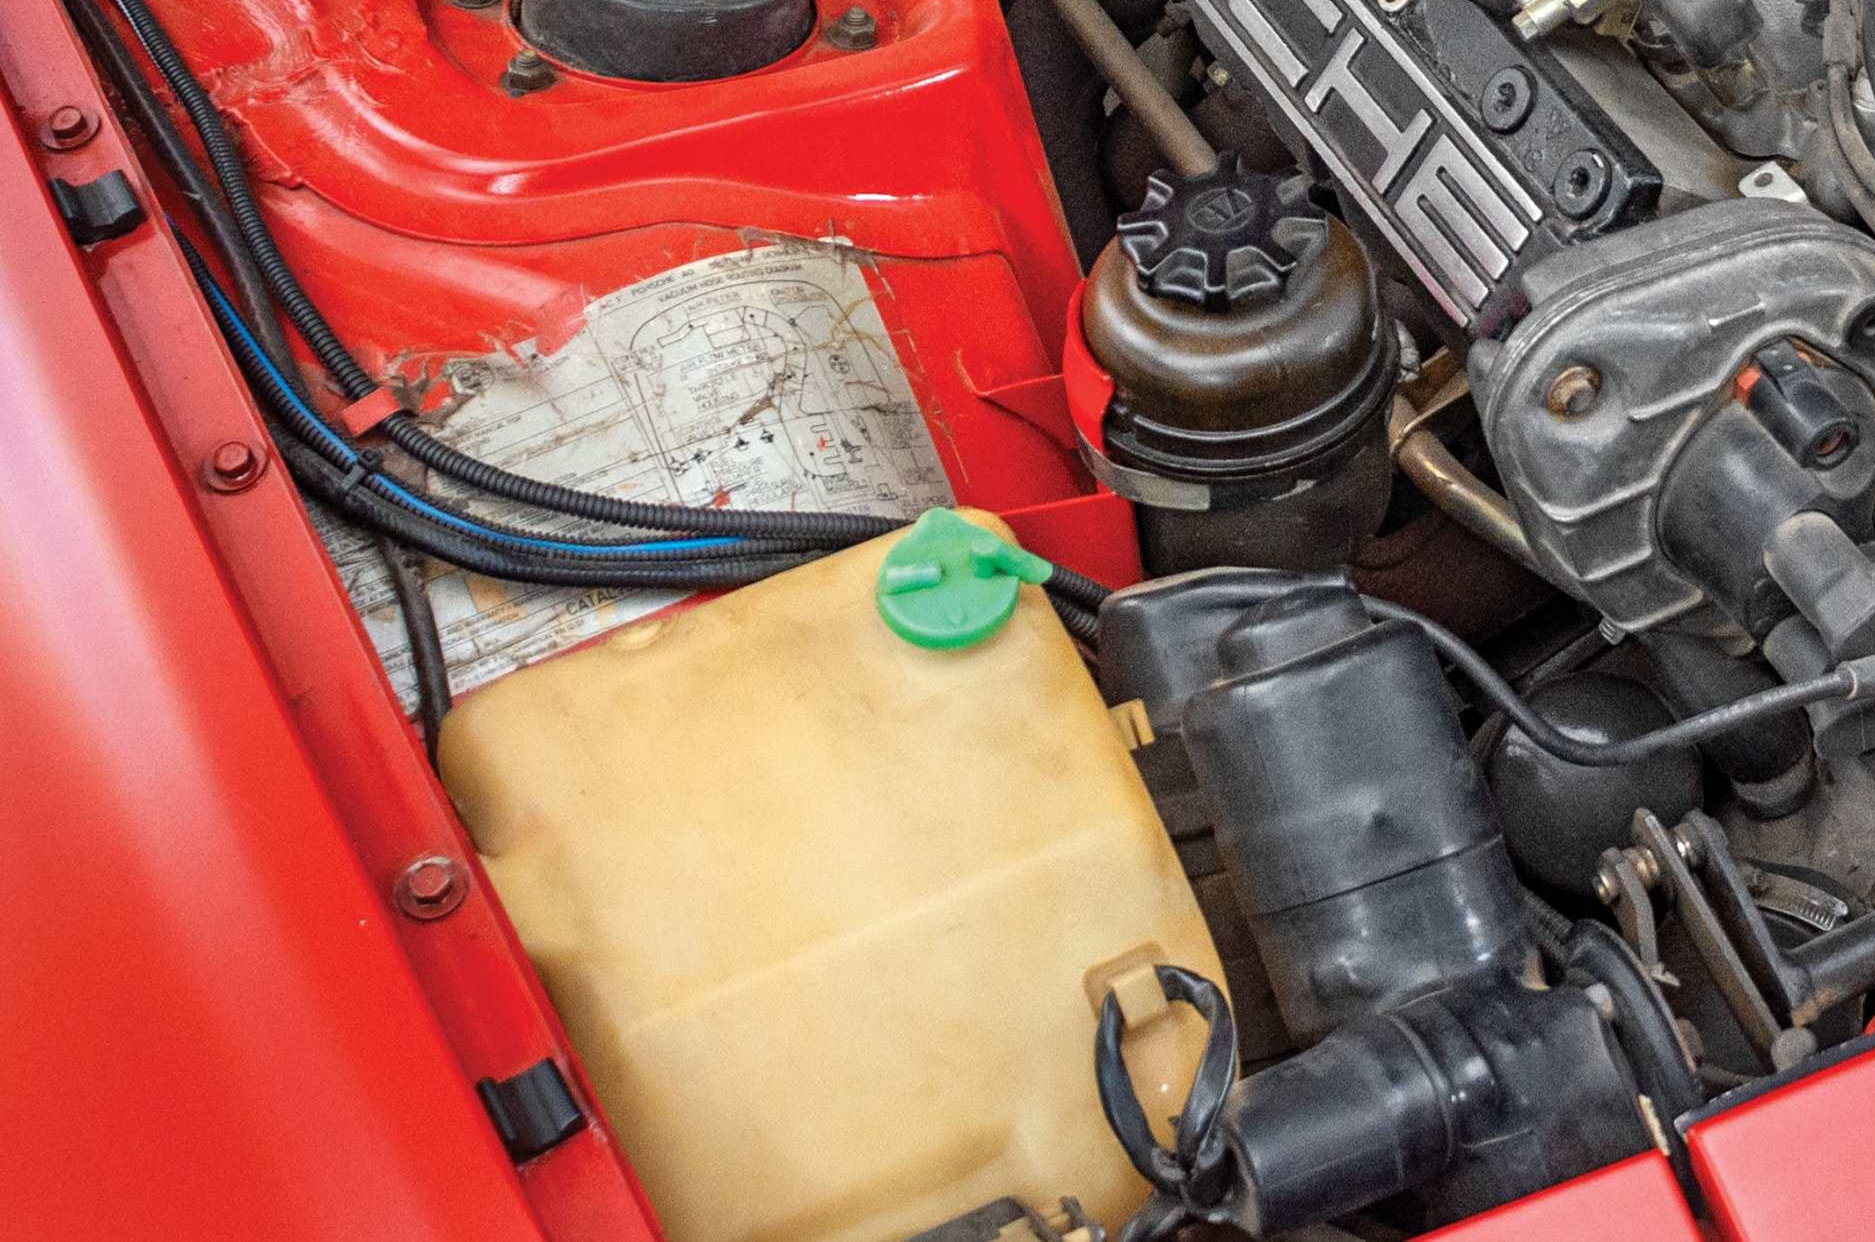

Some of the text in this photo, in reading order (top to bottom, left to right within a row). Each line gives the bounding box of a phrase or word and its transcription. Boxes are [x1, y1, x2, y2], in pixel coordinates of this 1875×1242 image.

[657, 283, 698, 303] VACUUM
[700, 275, 722, 289] HOSE
[765, 263, 803, 276] DIAGRAM
